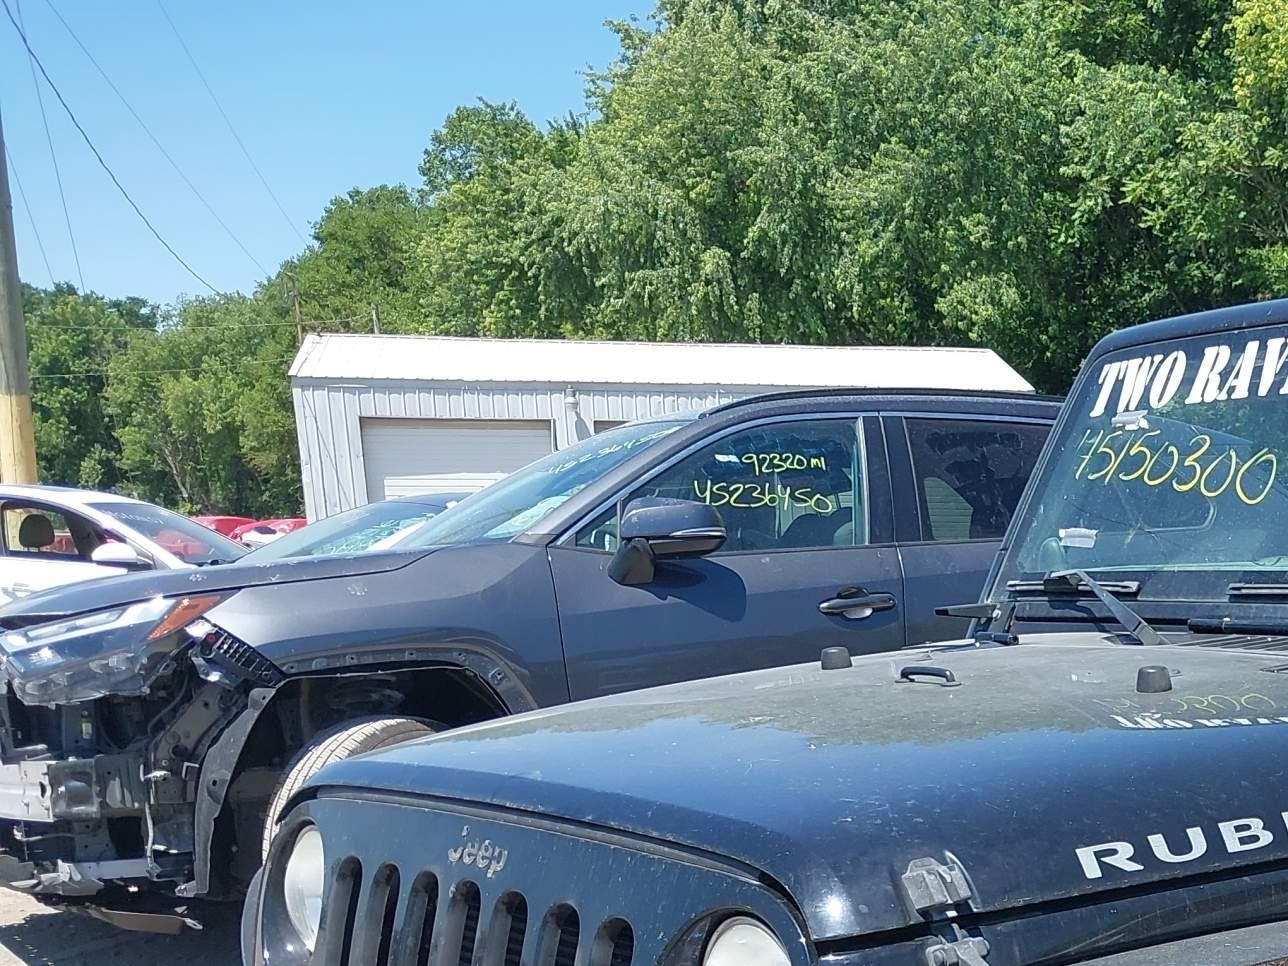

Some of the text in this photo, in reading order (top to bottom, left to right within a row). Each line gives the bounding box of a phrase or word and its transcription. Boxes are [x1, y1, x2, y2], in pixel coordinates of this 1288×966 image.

[1089, 350, 1187, 418] TWO
[741, 453, 807, 476] 92320
[693, 479, 832, 513] 45236450
[447, 824, 508, 880] Jeep
